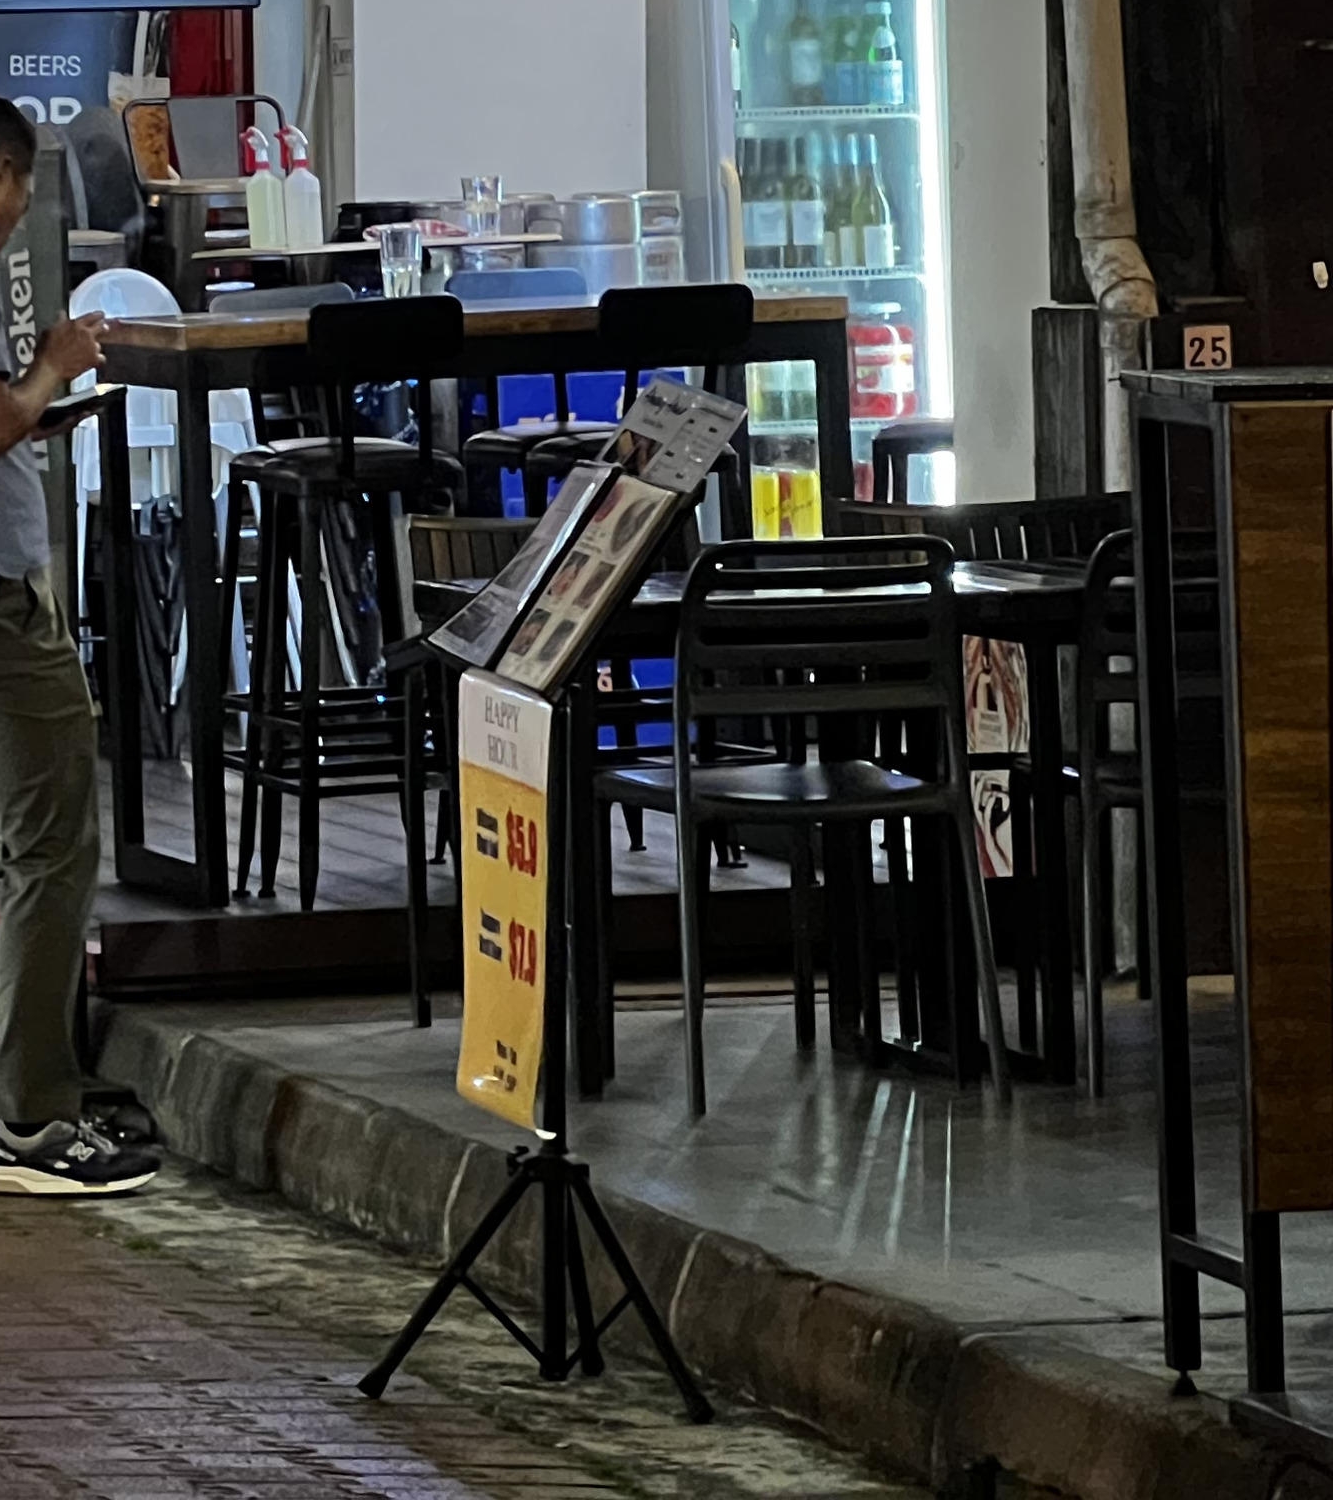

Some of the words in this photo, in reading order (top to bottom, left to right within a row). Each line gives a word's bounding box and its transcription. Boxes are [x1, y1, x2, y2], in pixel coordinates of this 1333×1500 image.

[9, 53, 81, 77] BEERS
[1188, 335, 1227, 368] 25
[483, 696, 521, 734] HAPPY
